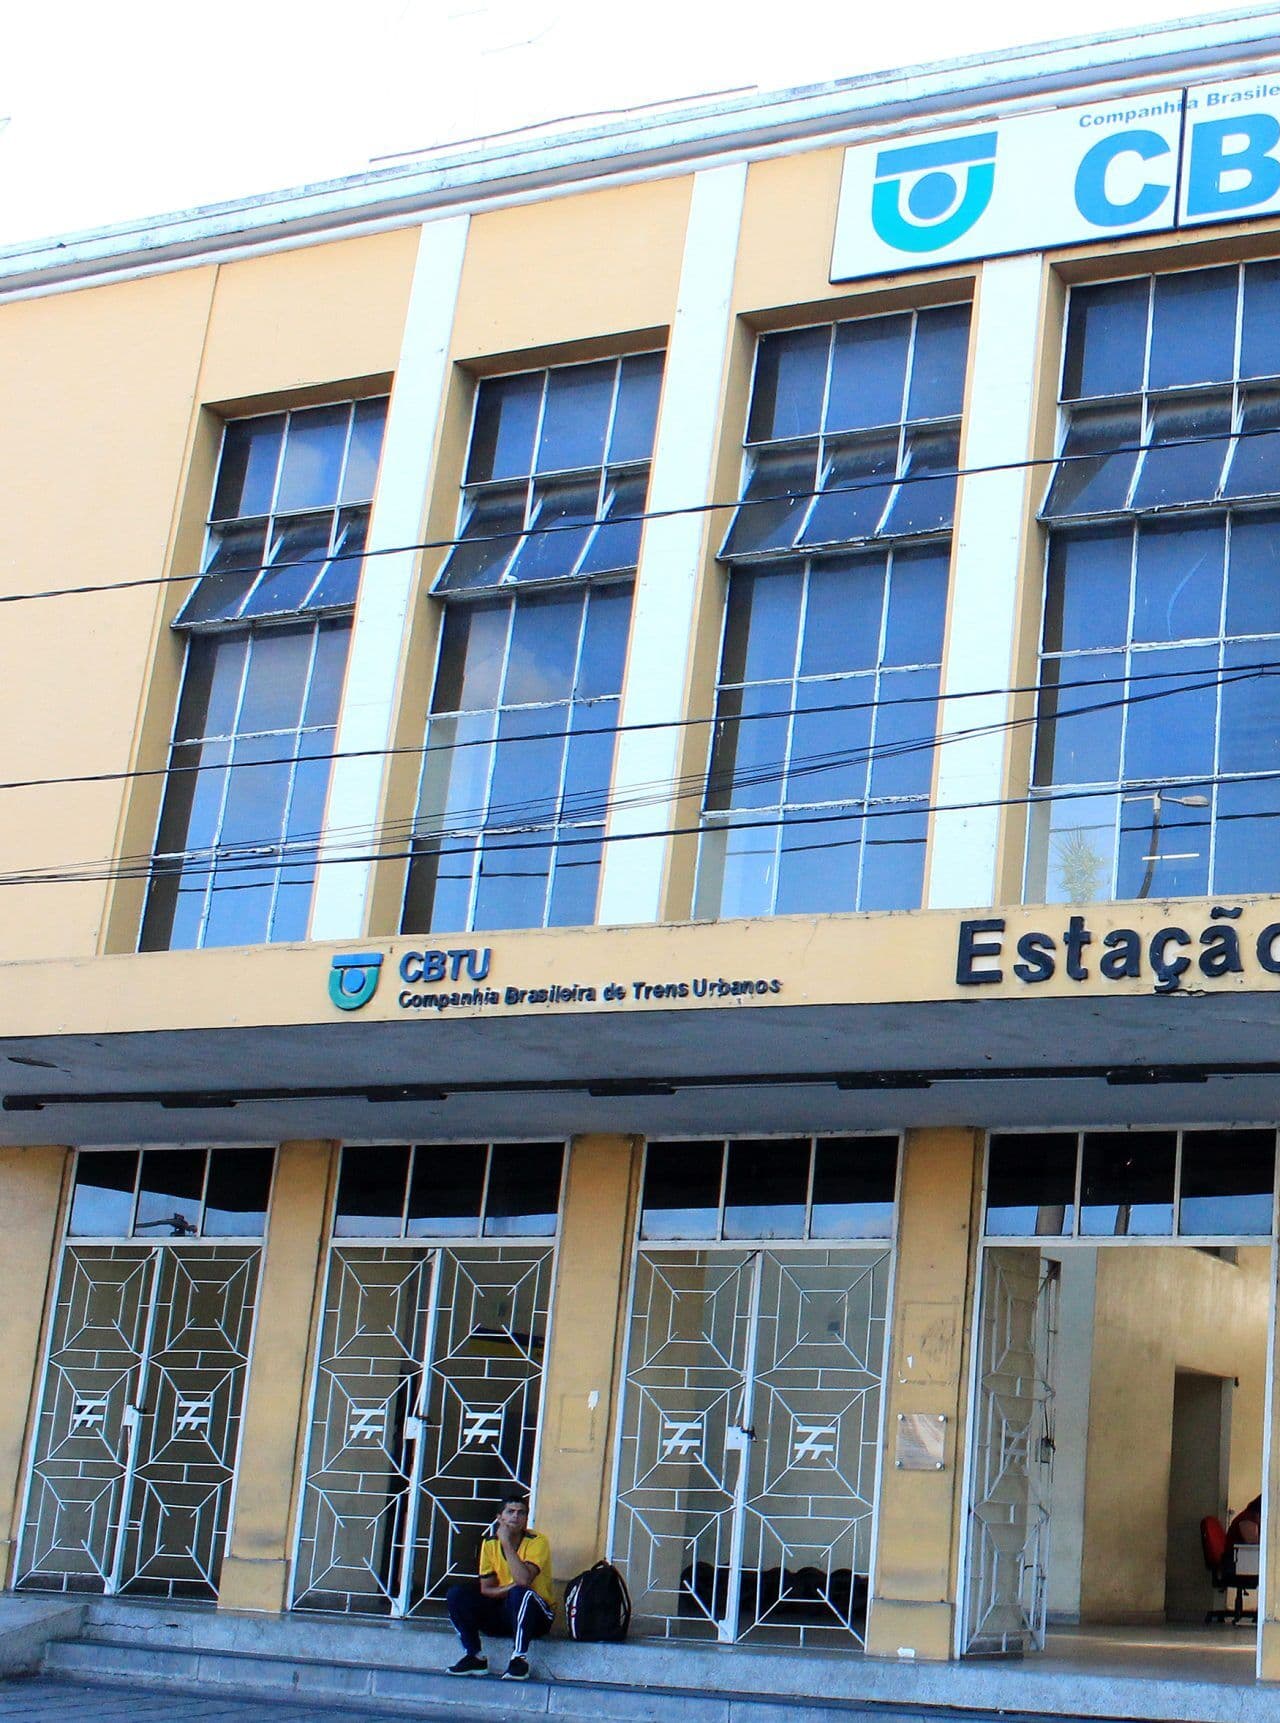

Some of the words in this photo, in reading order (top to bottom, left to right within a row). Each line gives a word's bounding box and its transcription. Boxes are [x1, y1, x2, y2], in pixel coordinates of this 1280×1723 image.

[1079, 99, 1198, 129] Companhia
[399, 948, 491, 983] CBTU
[399, 987, 500, 1011] Companhia
[504, 983, 597, 1005] Brasileira
[603, 982, 627, 1001] de
[632, 981, 690, 1000] Trens
[692, 977, 783, 998] Urbanos
